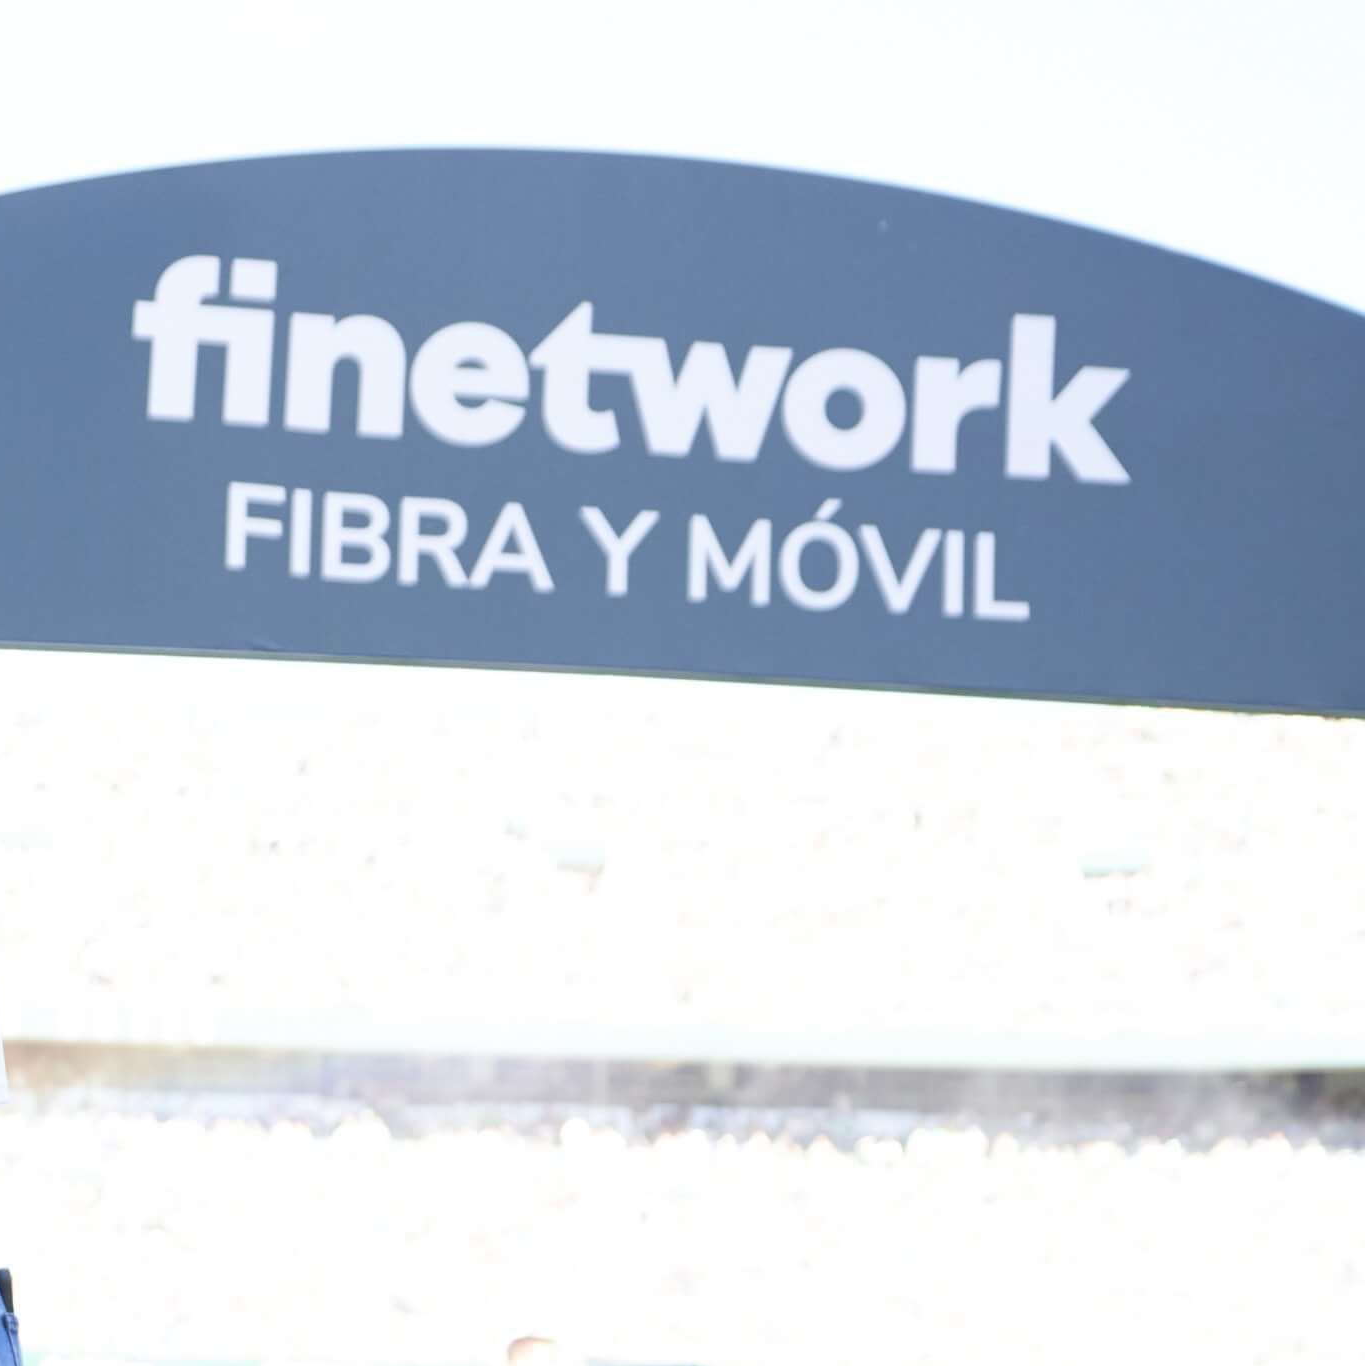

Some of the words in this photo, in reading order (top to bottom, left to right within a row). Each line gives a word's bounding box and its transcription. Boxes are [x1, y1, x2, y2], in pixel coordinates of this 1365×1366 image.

[131, 254, 1132, 485] finetwork
[224, 480, 555, 593] FIBRA
[580, 505, 660, 597] Y
[687, 497, 1031, 623] MÓVIL
